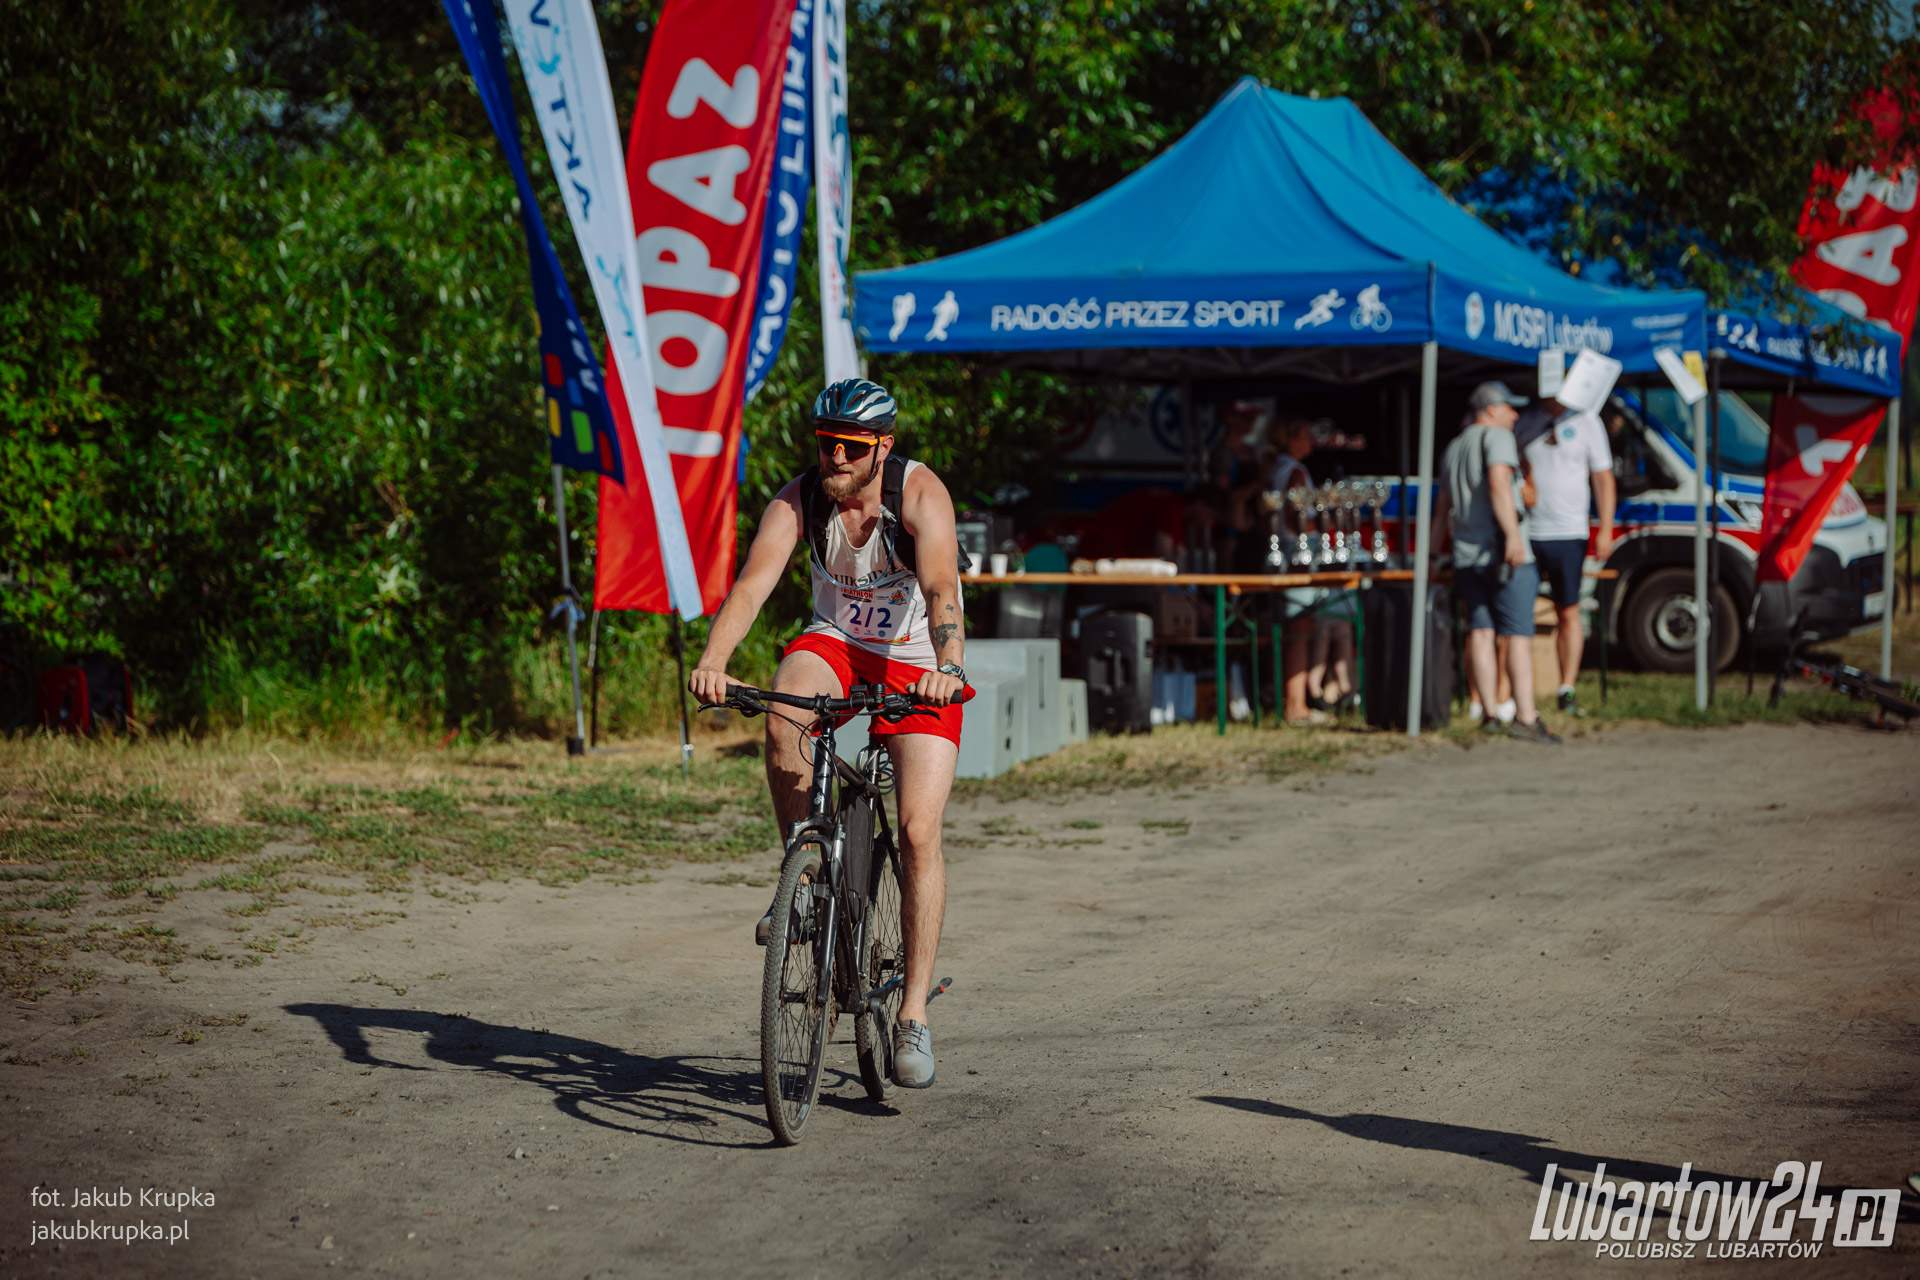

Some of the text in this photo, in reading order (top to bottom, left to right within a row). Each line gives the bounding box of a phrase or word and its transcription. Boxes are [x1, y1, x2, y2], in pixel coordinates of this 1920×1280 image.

[991, 297, 1285, 331] RADOŚĆ PRZEZ SPORT
